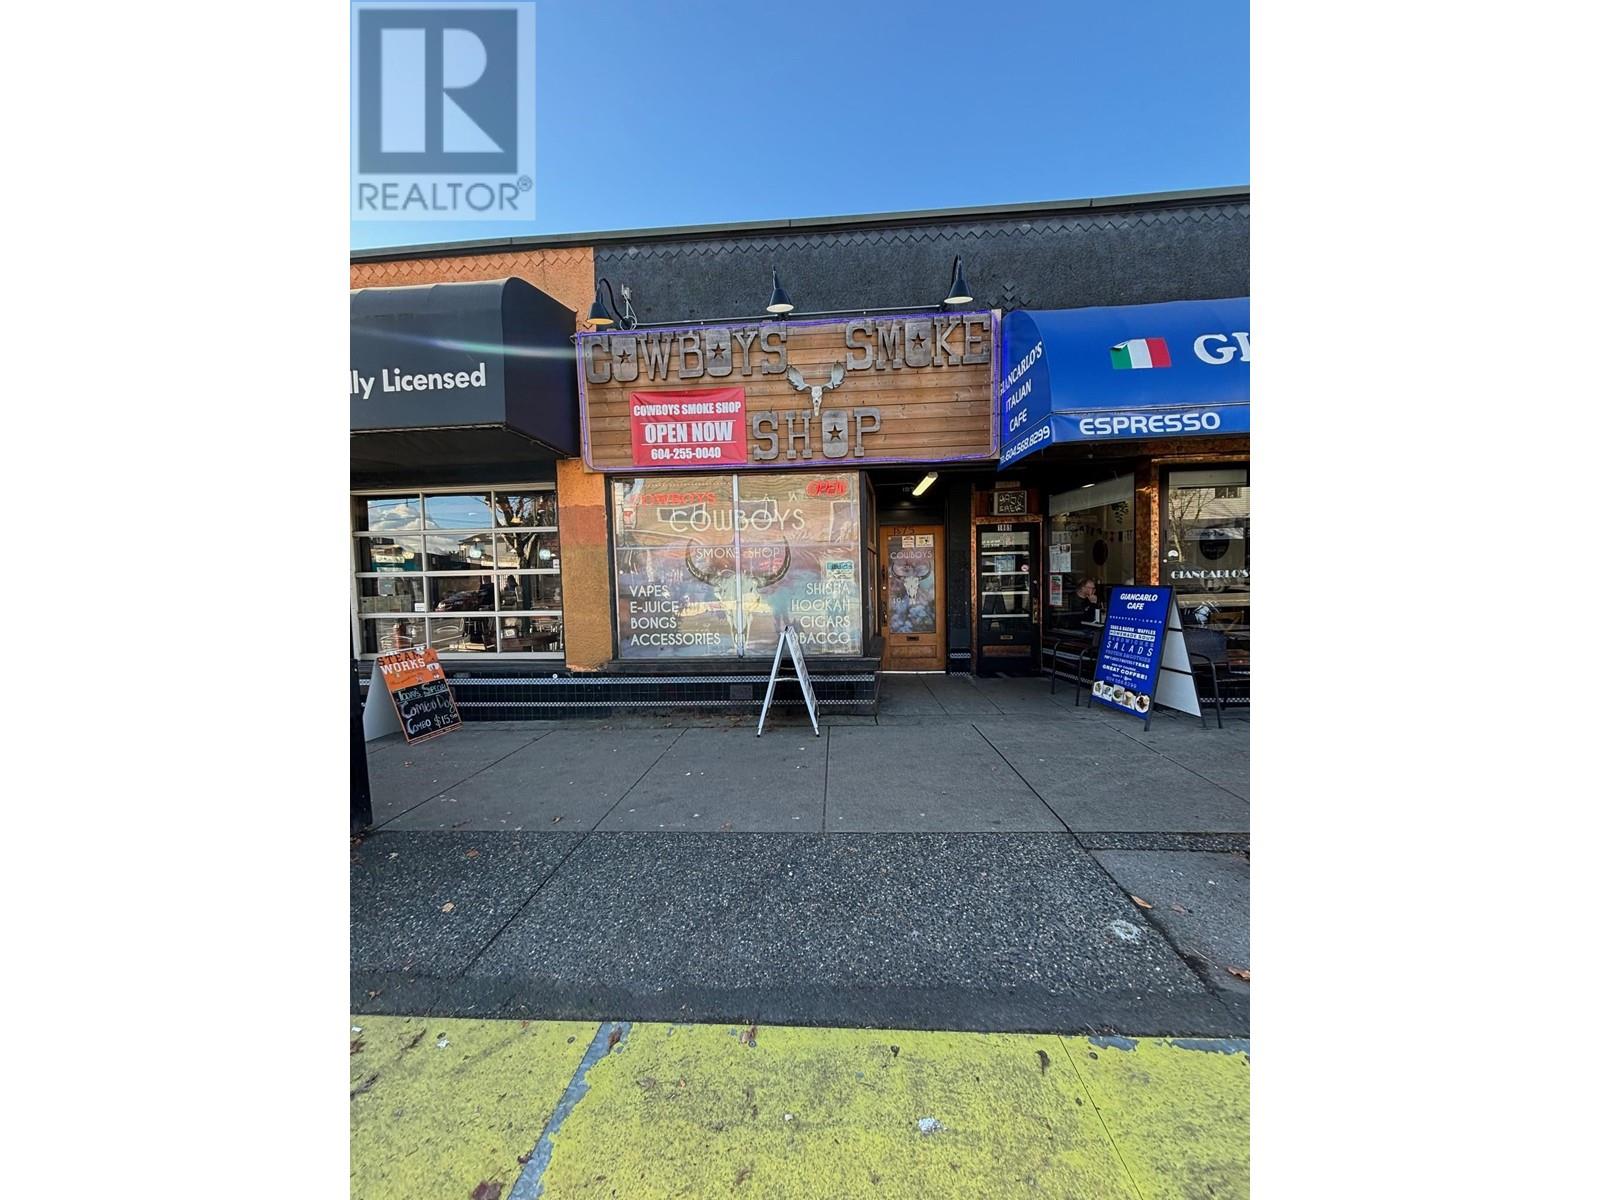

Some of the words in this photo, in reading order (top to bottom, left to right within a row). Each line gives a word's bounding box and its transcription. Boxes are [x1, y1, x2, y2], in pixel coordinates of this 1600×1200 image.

[584, 324, 788, 384] COWBOYS
[845, 312, 991, 371] SMOKE
[382, 362, 487, 392] Licensed
[1006, 378, 1032, 413] ITALIAN
[634, 404, 680, 416] COWBOYS
[681, 402, 715, 415] SMOKE
[715, 401, 742, 414] SHOP
[1009, 408, 1028, 432] CAFE
[1079, 412, 1221, 436] ESPRESSO
[645, 422, 688, 443] OPEN
[691, 421, 733, 442] NOW
[752, 407, 881, 460] SHOP
[651, 446, 722, 460] 604-255-0040
[669, 508, 805, 532] COWBOYS
[890, 550, 933, 560] COWBOYS
[629, 584, 670, 598] VAPES
[1119, 593, 1159, 602] GIANCARLO
[629, 601, 680, 613] E-JUICE
[791, 599, 850, 612] HOOKAH
[1127, 602, 1145, 610] CAFE
[631, 616, 677, 629] BONGS
[800, 615, 850, 628] CIGARS
[630, 633, 721, 646] ACCESSORIES
[1106, 640, 1154, 656] SALADS
[380, 658, 426, 675] WORKS
